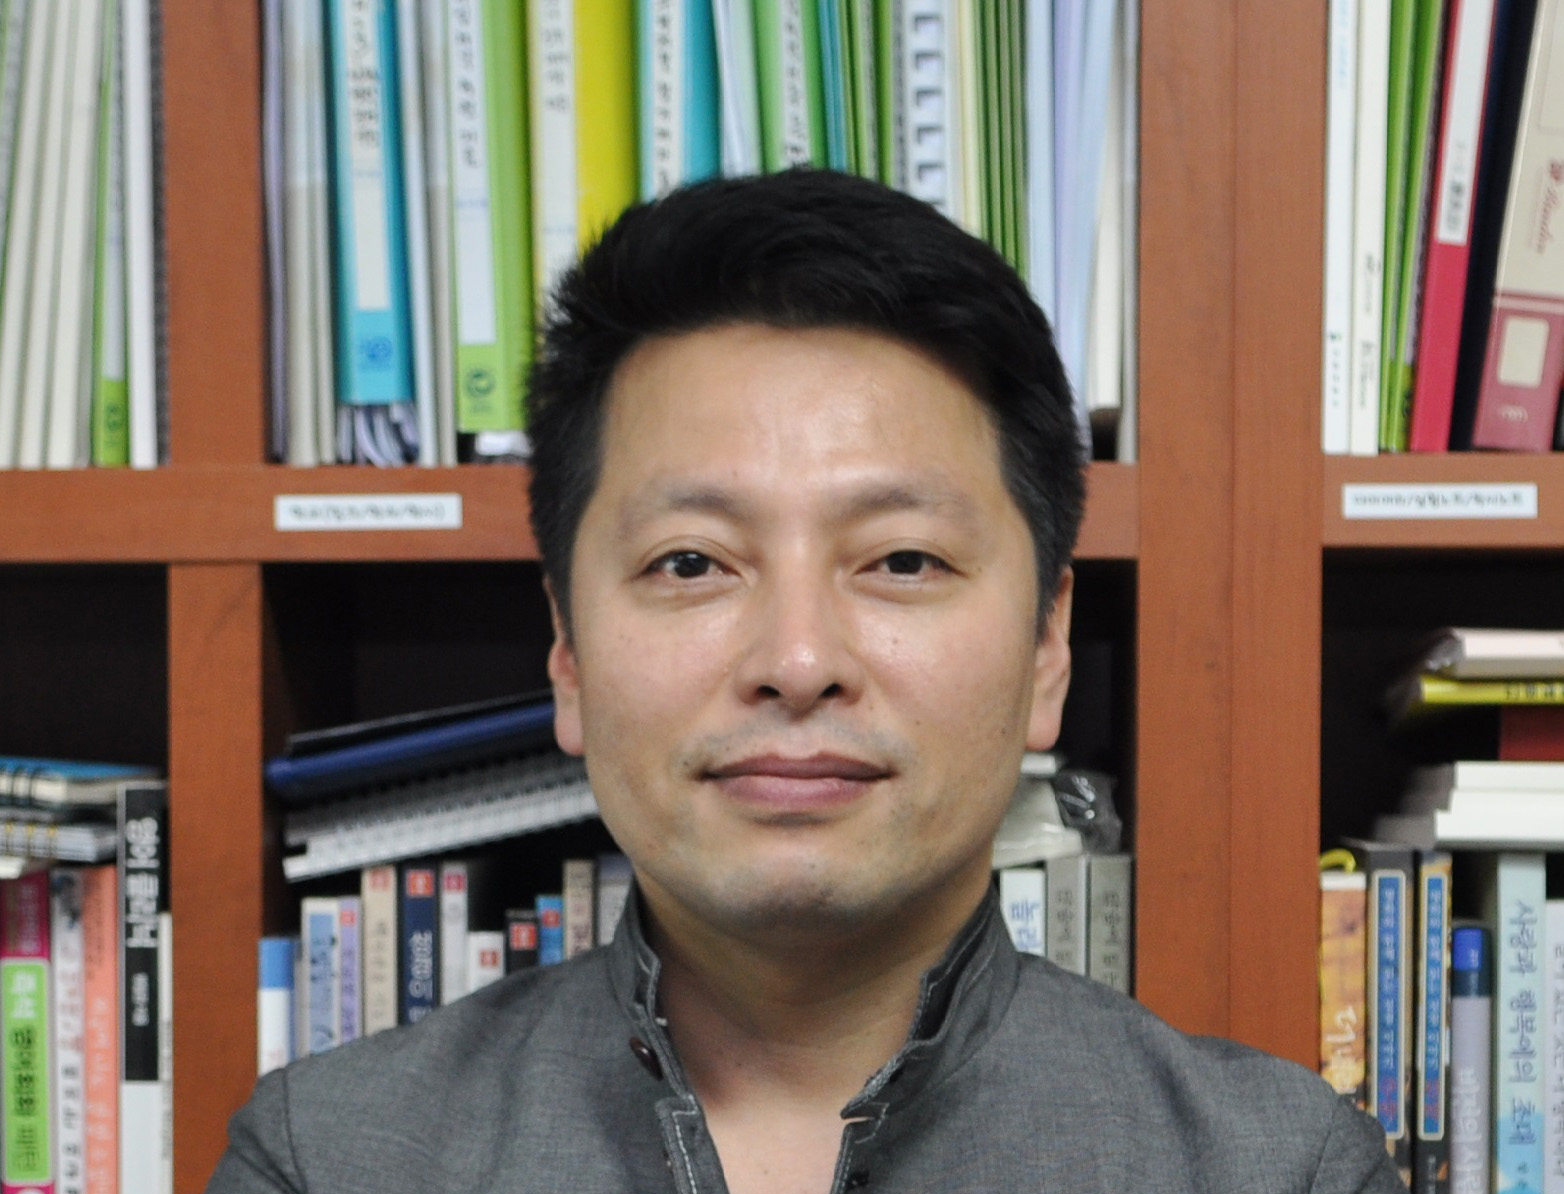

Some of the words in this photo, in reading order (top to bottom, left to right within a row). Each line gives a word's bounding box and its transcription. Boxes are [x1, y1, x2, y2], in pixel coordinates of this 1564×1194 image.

[126, 817, 160, 869] 영어
[1508, 900, 1538, 977] 사랑과
[1508, 989, 1538, 1084] 행복에의
[1451, 1066, 1483, 1144] 비전의
[1508, 1097, 1538, 1146] 초대
